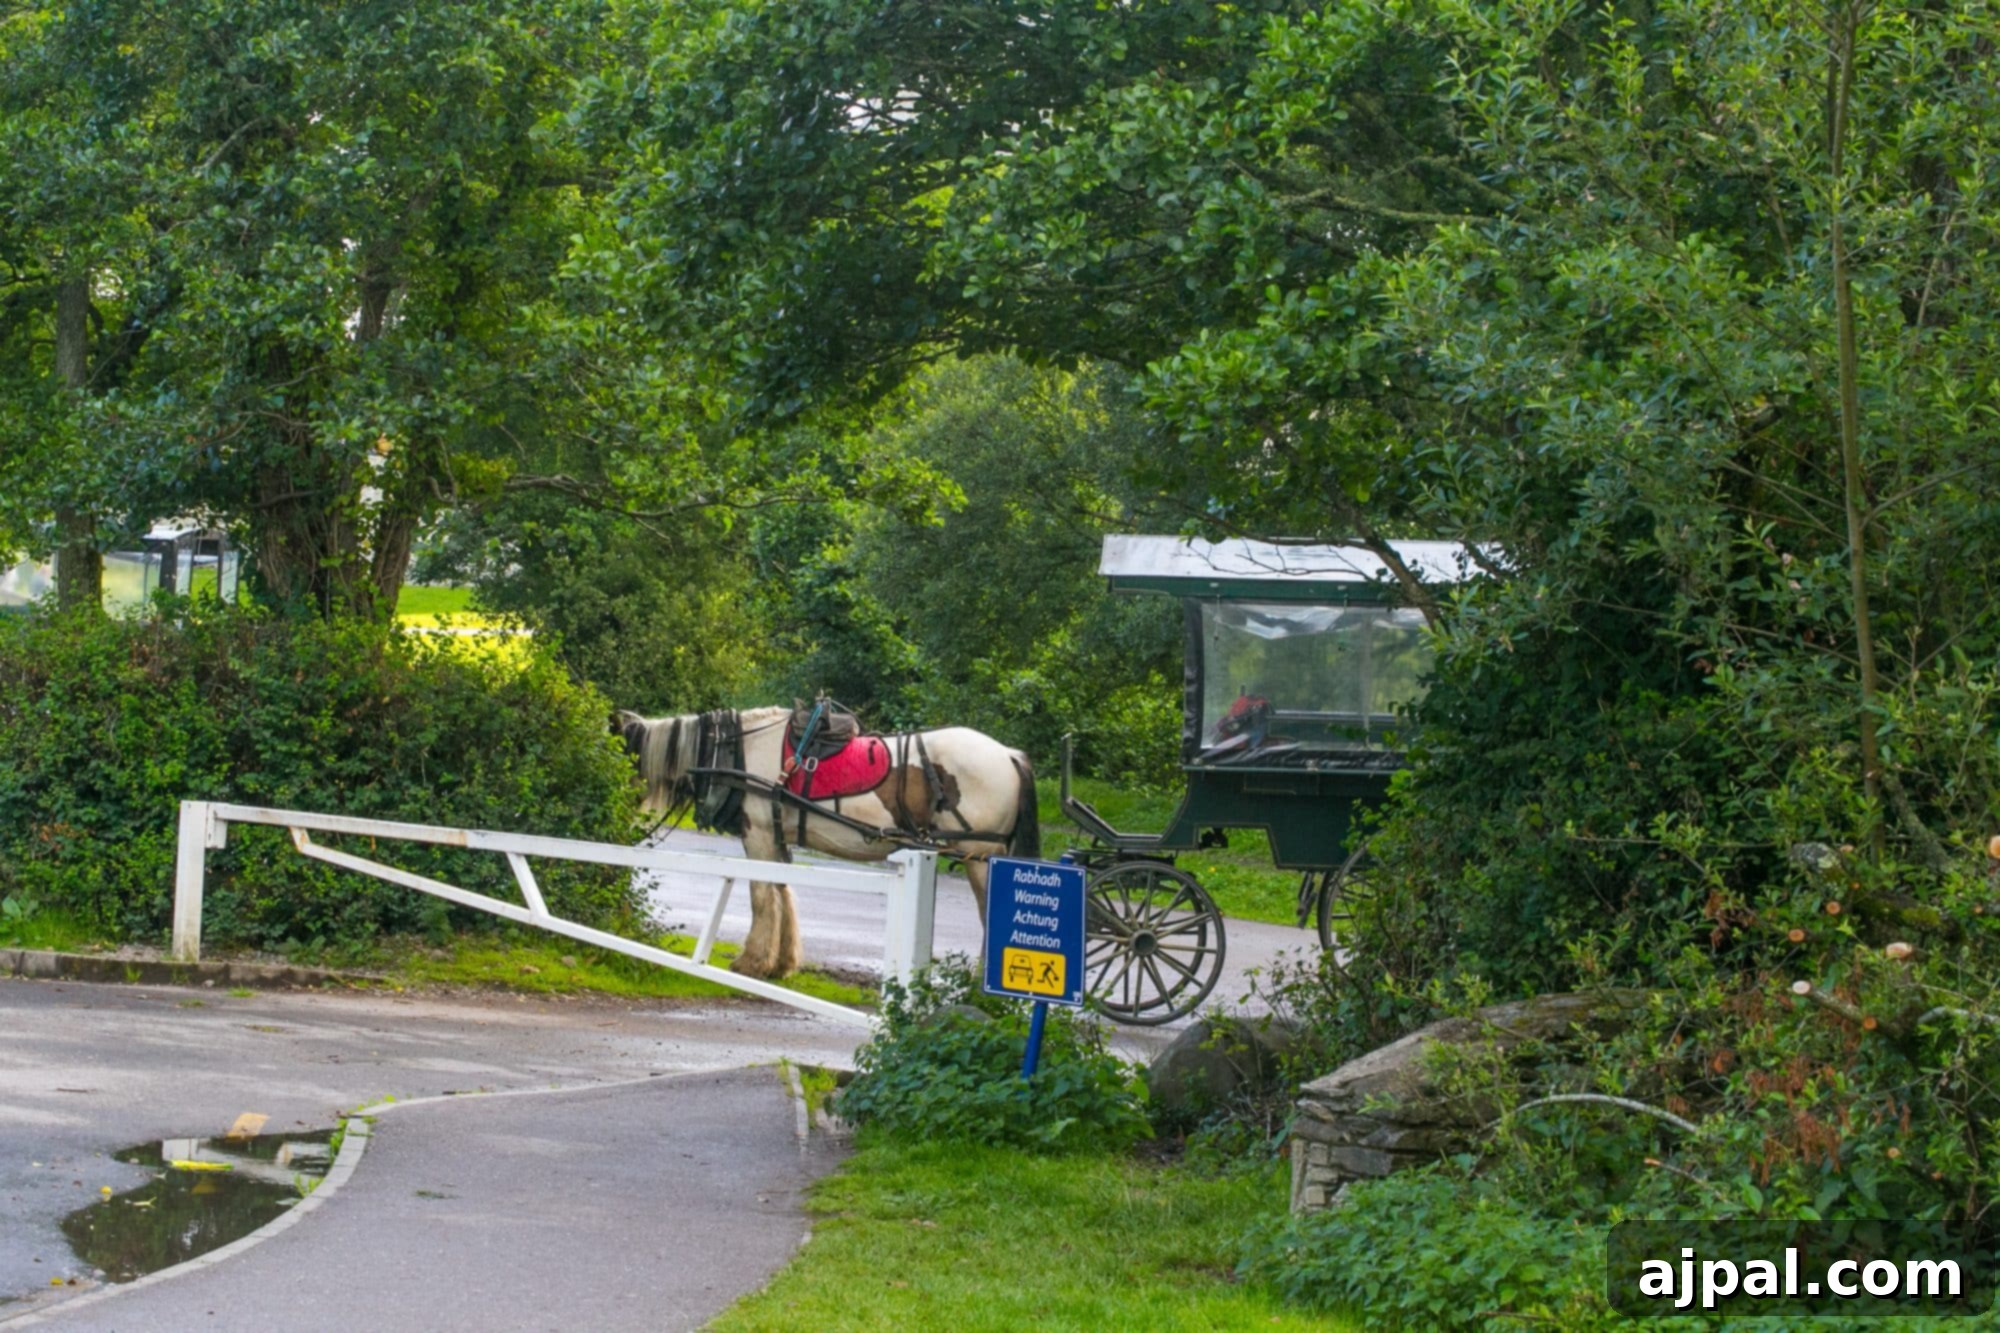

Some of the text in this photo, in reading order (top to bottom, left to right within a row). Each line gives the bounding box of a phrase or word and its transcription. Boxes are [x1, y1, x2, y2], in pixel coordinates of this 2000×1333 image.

[1013, 868, 1061, 887] Rabhadh
[1014, 889, 1060, 911] Warning
[1012, 909, 1059, 931] Achtung
[1009, 930, 1061, 949] Attention
